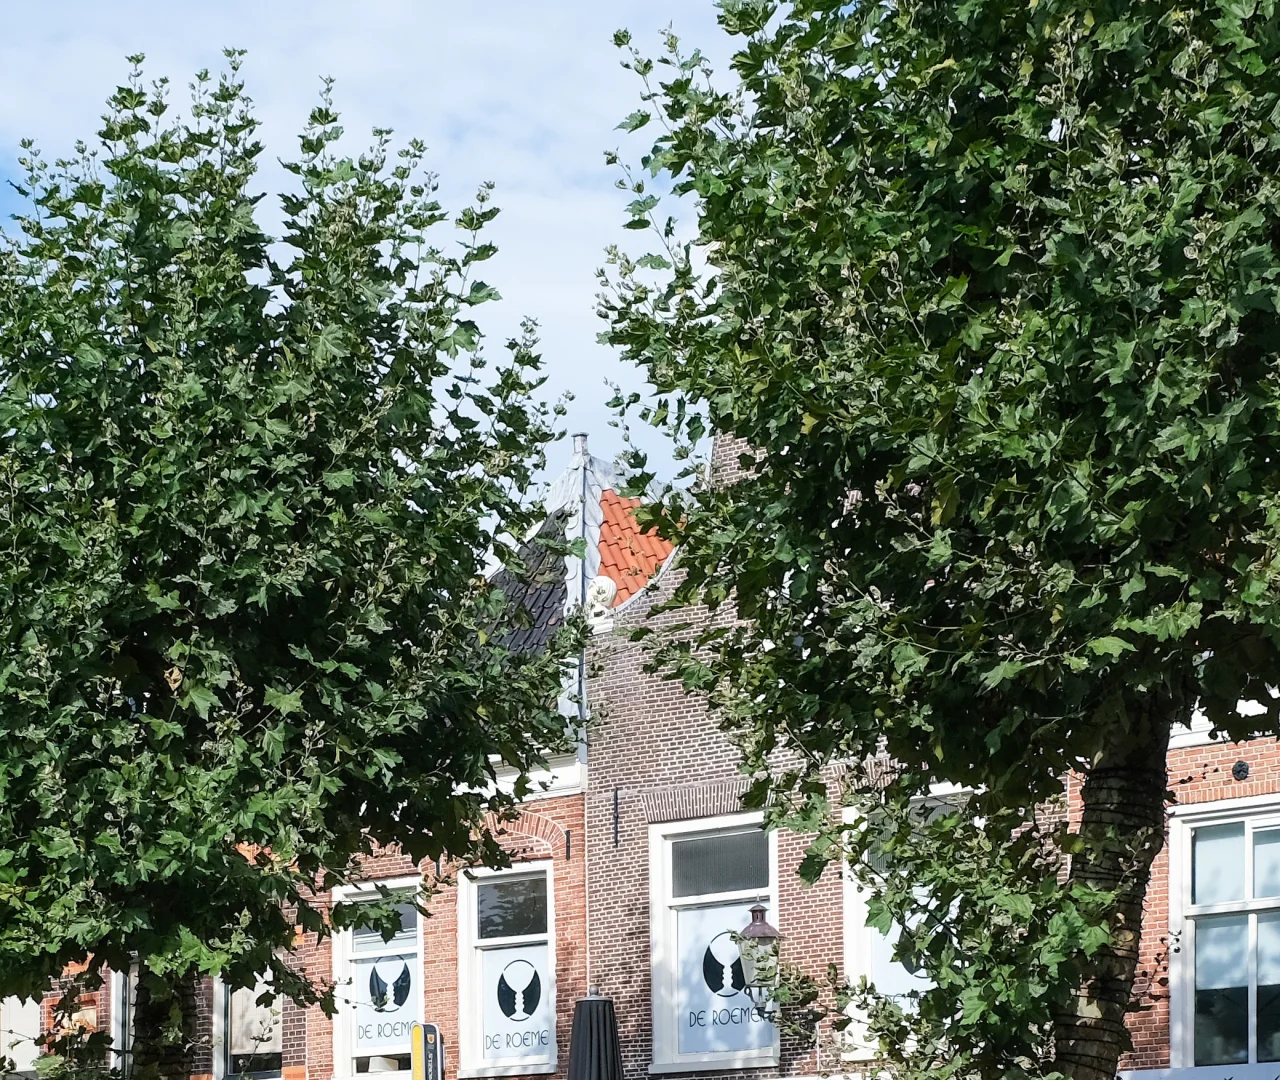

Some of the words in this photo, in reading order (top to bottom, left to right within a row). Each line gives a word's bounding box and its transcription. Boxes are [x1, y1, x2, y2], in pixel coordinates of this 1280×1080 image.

[690, 1010, 706, 1028] DE
[712, 1007, 765, 1026] ROEME
[358, 1024, 372, 1040] DE
[485, 1034, 500, 1050] DE
